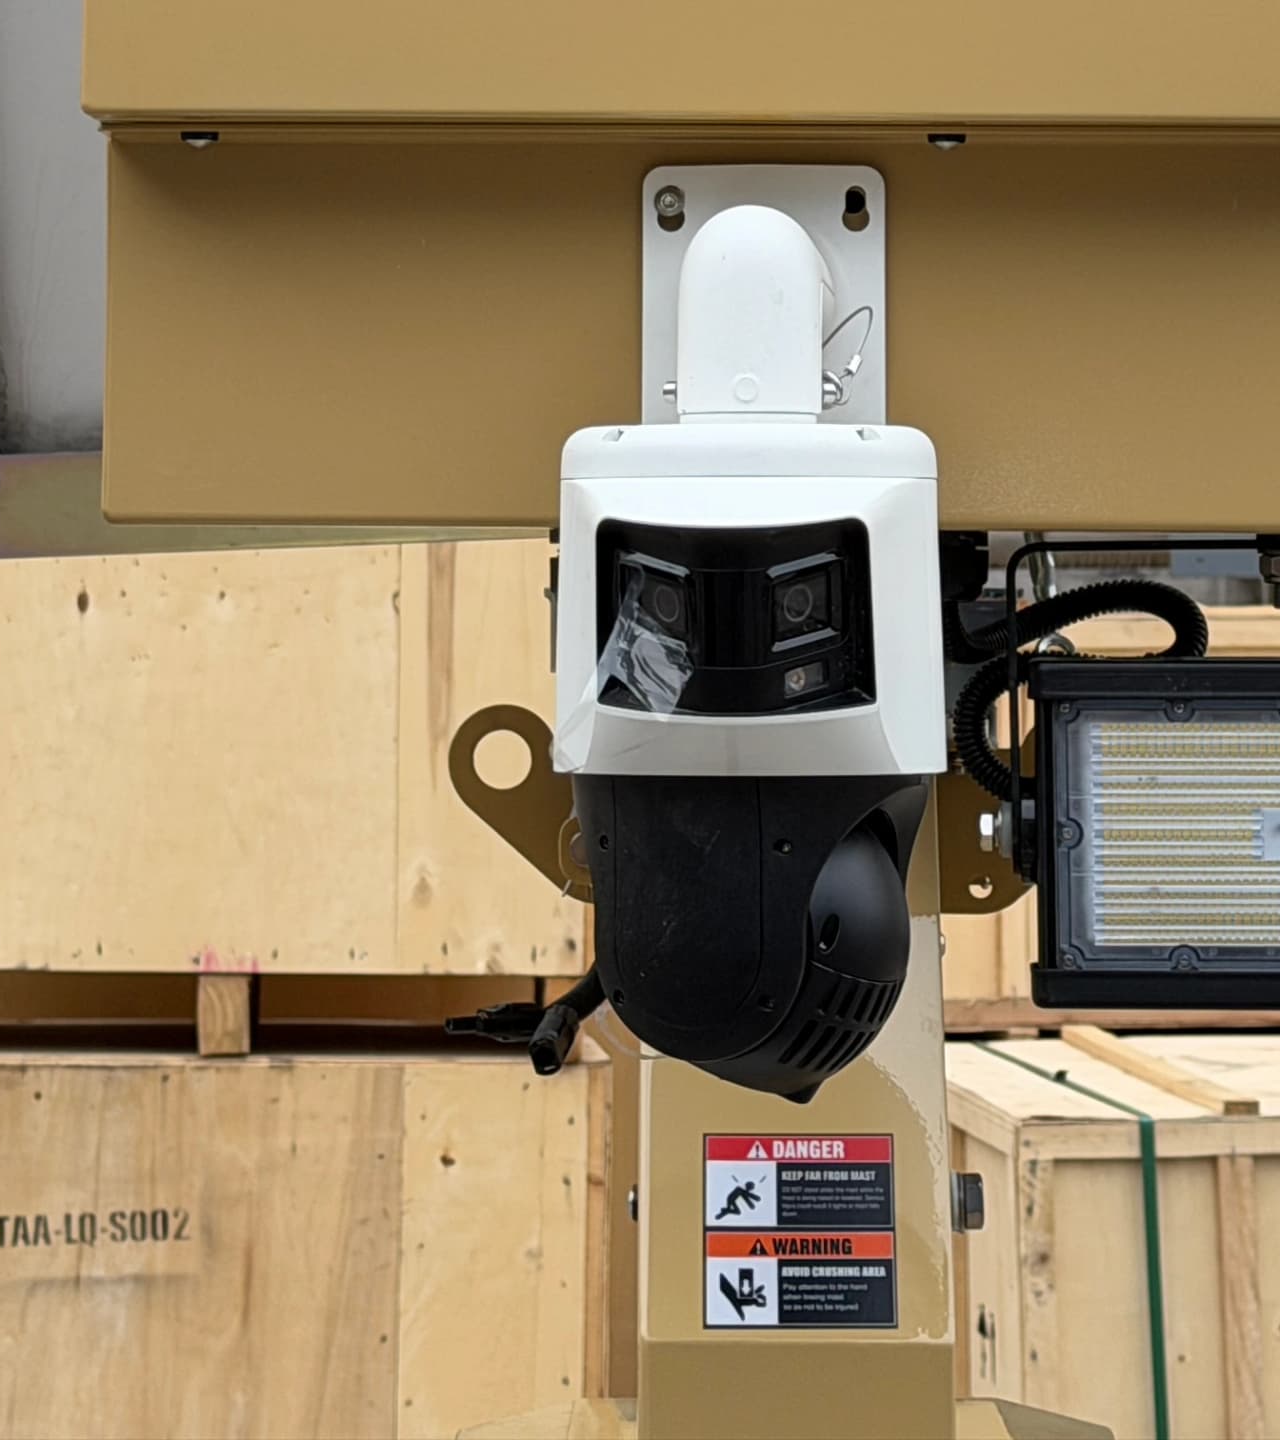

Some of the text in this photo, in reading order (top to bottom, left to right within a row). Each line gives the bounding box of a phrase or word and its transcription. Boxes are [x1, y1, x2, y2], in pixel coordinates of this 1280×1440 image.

[773, 1140, 845, 1159] DANGER
[781, 1170, 876, 1181] KEEP FAR FROM MAST
[772, 1238, 853, 1256] WARNING
[781, 1266, 887, 1277] AVOID CRUSHING AREA
